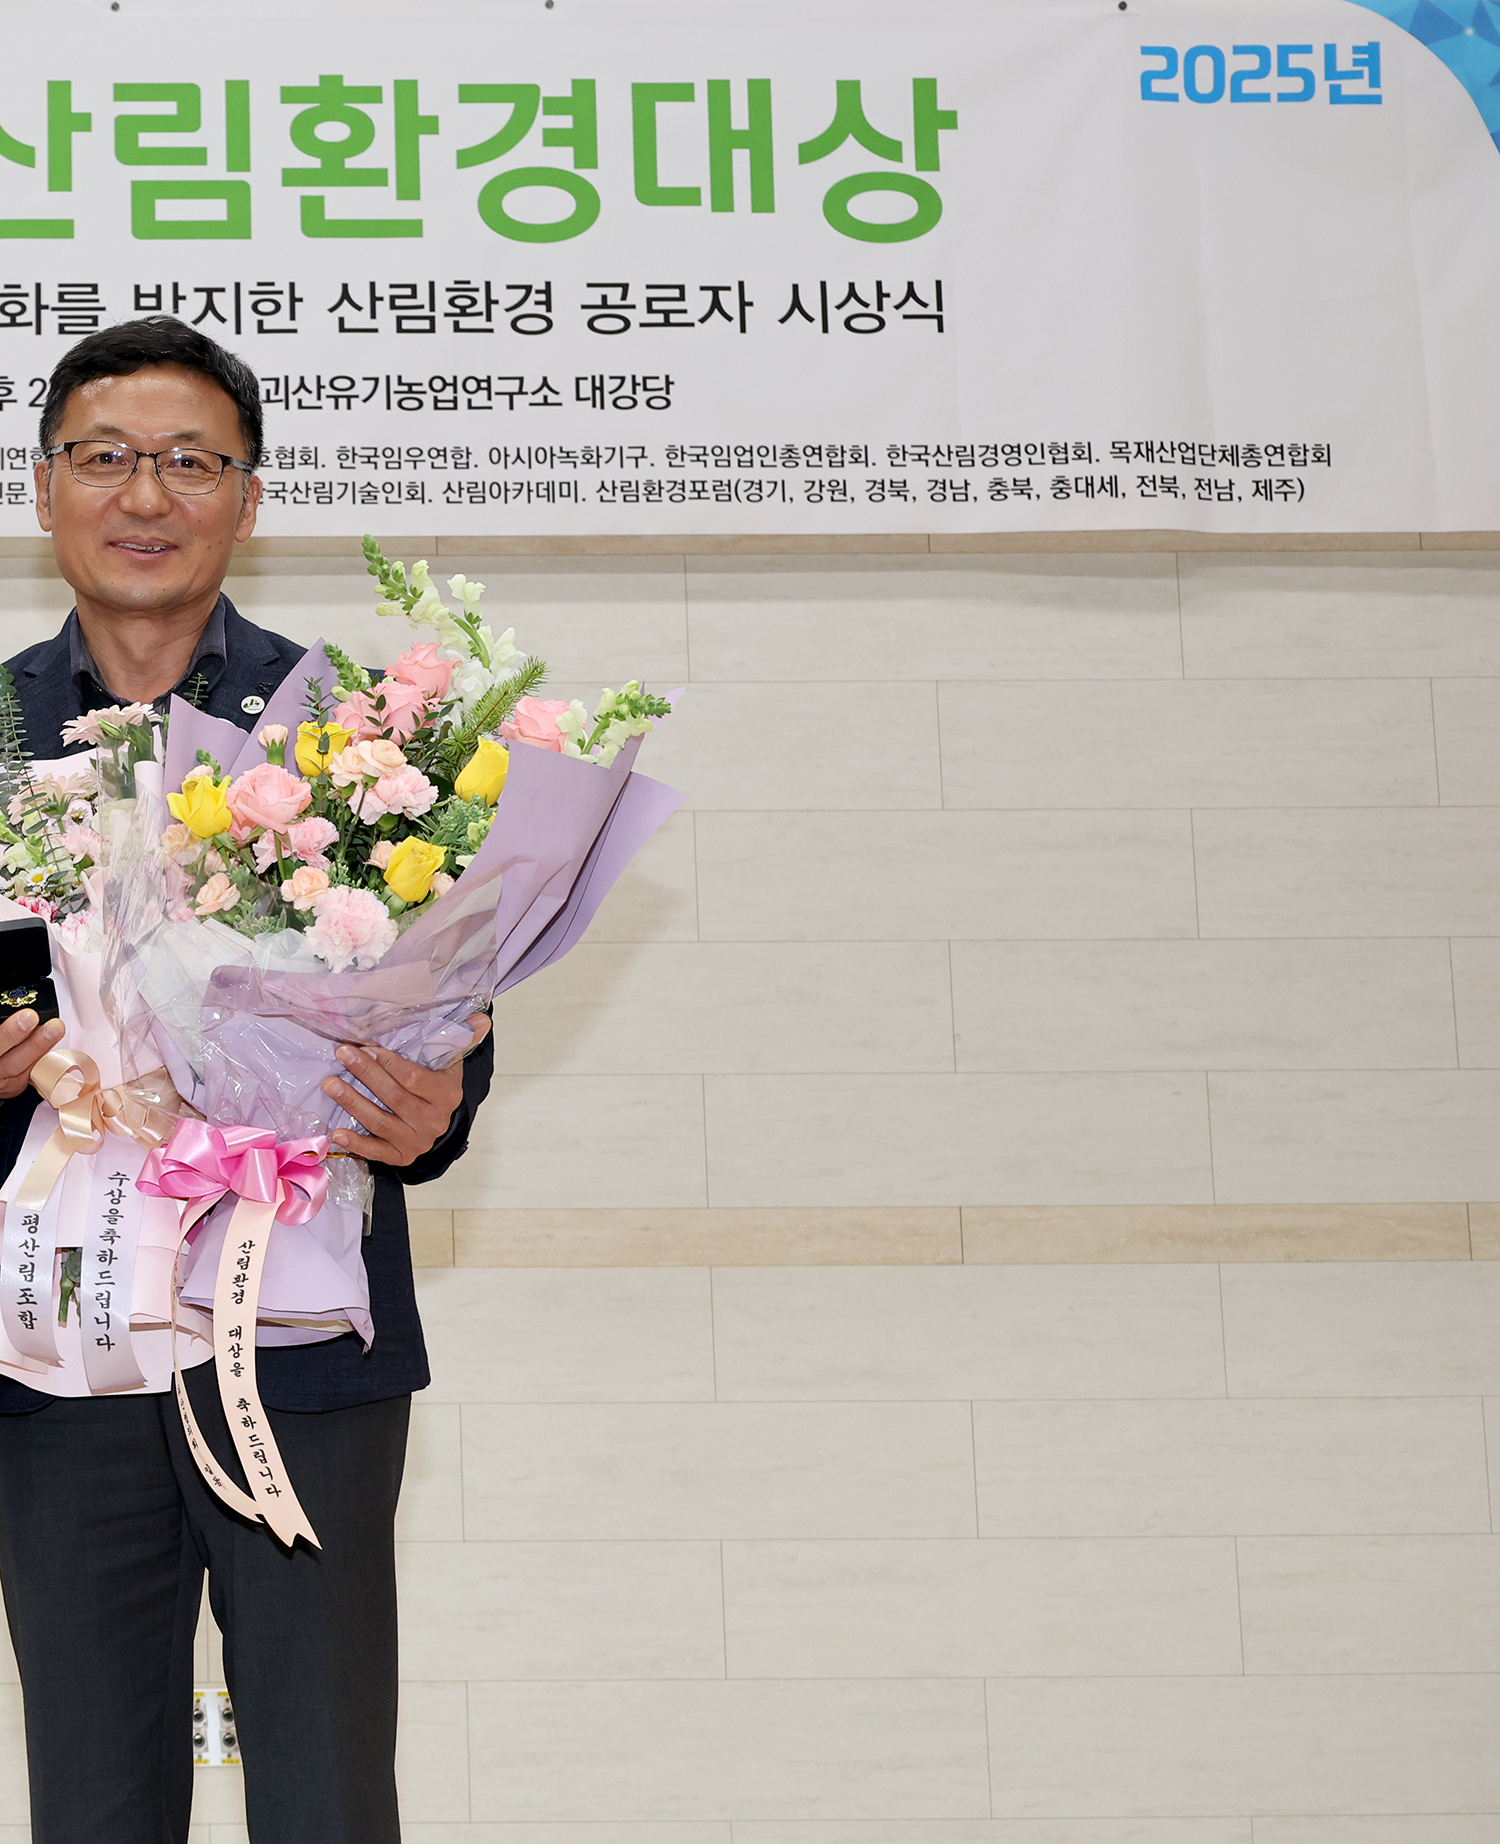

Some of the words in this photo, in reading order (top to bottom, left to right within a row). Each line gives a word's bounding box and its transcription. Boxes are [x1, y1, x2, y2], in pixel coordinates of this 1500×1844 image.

[1140, 41, 1383, 105] 2025년
[327, 279, 554, 336] 산림환경
[580, 280, 754, 336] 공로자
[777, 279, 945, 335] 시상식
[261, 373, 563, 411] 괴산유기농업연구소
[574, 373, 675, 411] 대강당
[336, 445, 479, 471] 한국임우연합.
[488, 445, 655, 470] 아시아녹화기구.
[664, 443, 877, 469] 한국임업인총연합회.
[886, 441, 1100, 468] 한국산림경영인협회.
[1109, 439, 1332, 469] 목재산업단체총연합회
[260, 480, 433, 505] 국산림기술인회.
[442, 479, 587, 505] 산림아카데미.
[803, 478, 855, 504] 강원,
[865, 478, 917, 503] 경북,
[926, 478, 978, 503] 경남,
[987, 476, 1041, 502] 충북,
[1049, 474, 1127, 500] 충대세,
[1136, 474, 1186, 500] 전북,
[1193, 477, 1243, 503] 전남,
[1251, 476, 1305, 503] 제주)
[230, 1239, 256, 1305] 산림환경
[226, 1325, 245, 1378] 대상을
[235, 1397, 282, 1499] 축하드립니다
